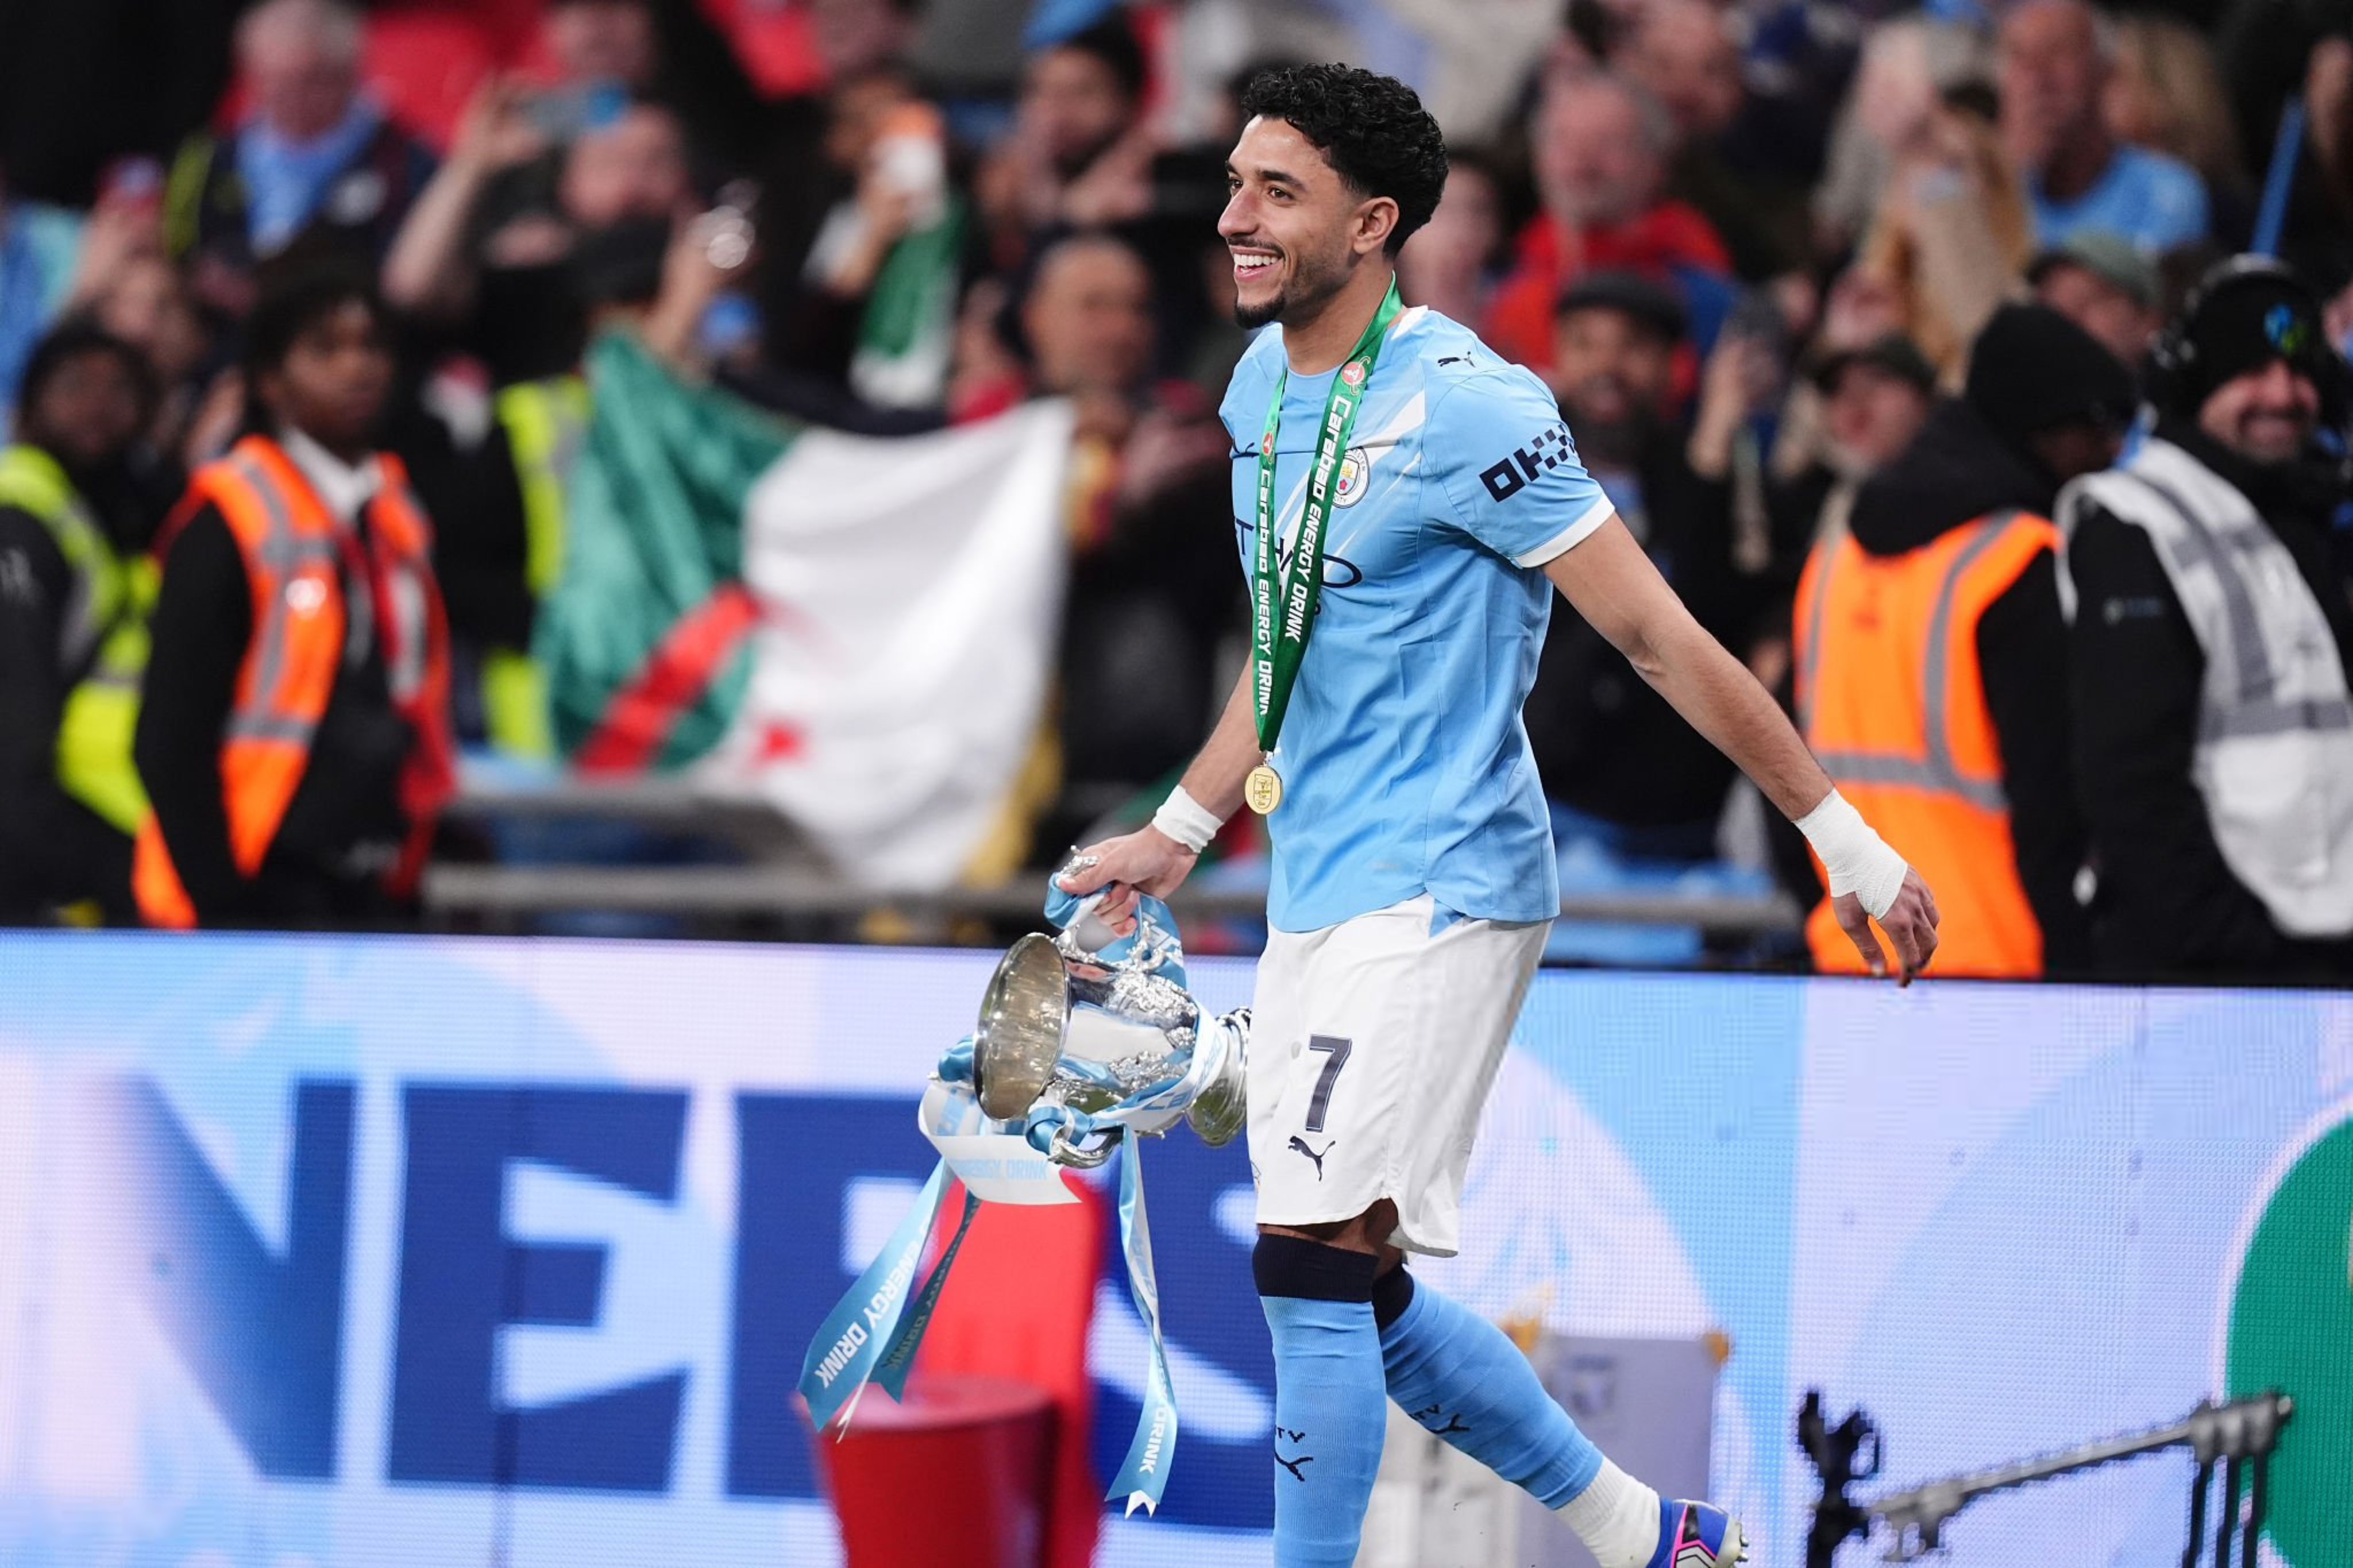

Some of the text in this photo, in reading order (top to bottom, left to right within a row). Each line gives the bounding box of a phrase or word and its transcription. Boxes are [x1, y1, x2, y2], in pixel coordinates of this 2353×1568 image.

[1259, 469, 1271, 573] Carabao
[1285, 395, 1352, 643] Carabao ENERGY DRINK
[1257, 578, 1271, 655] ENERGY
[1305, 1033, 1352, 1133] 7
[815, 1239, 920, 1389] ENERGY DRINK
[1139, 1405, 1168, 1474] DRINK
